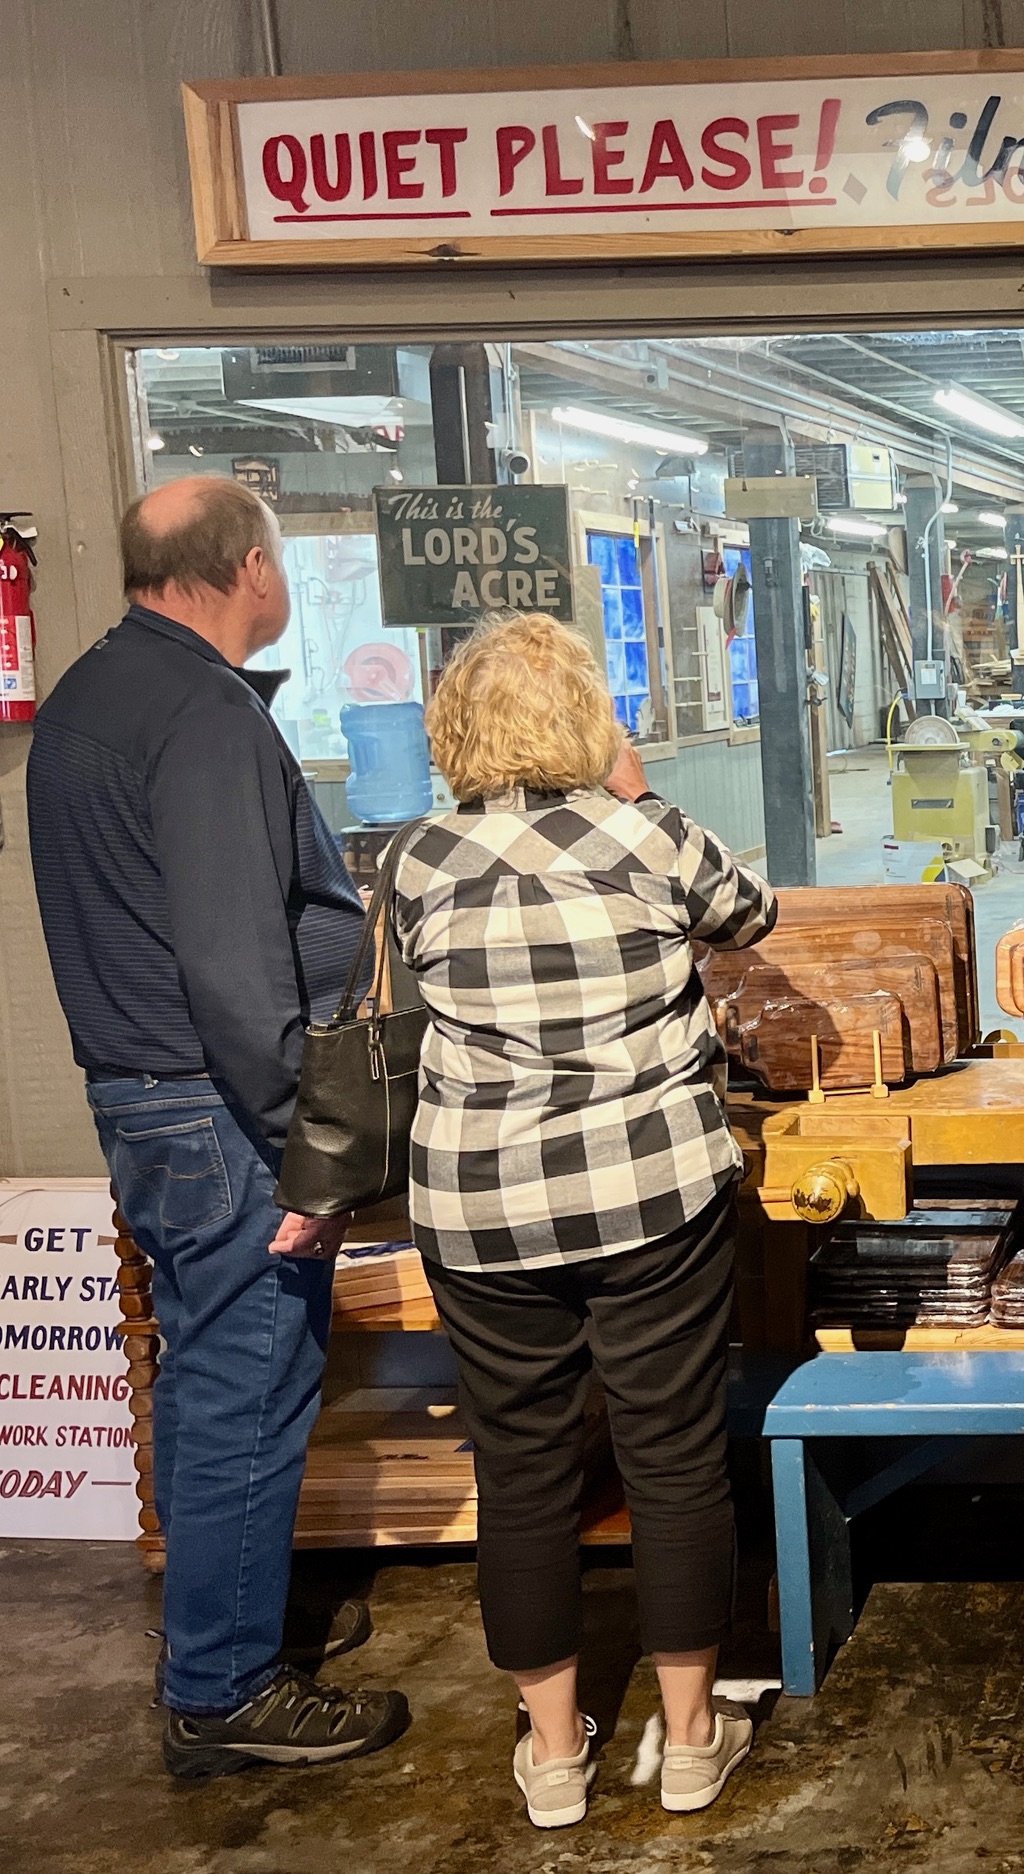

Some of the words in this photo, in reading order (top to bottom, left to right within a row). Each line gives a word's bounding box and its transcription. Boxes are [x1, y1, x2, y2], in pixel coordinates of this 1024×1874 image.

[262, 127, 468, 213] QUIET
[498, 98, 838, 198] PLEASE!
[388, 492, 438, 521] This
[445, 496, 464, 520] is
[469, 495, 503, 519] the
[402, 519, 540, 566] LORD'S
[452, 569, 561, 609] ACRE
[24, 1226, 92, 1253] GET
[0, 1275, 72, 1301] ARLY
[79, 1276, 121, 1301] STA
[0, 1324, 125, 1351] MORROW
[0, 1374, 130, 1401] CLEANING
[0, 1426, 48, 1447] WORK
[56, 1425, 135, 1449] STATION
[0, 1470, 88, 1499] ODAY
